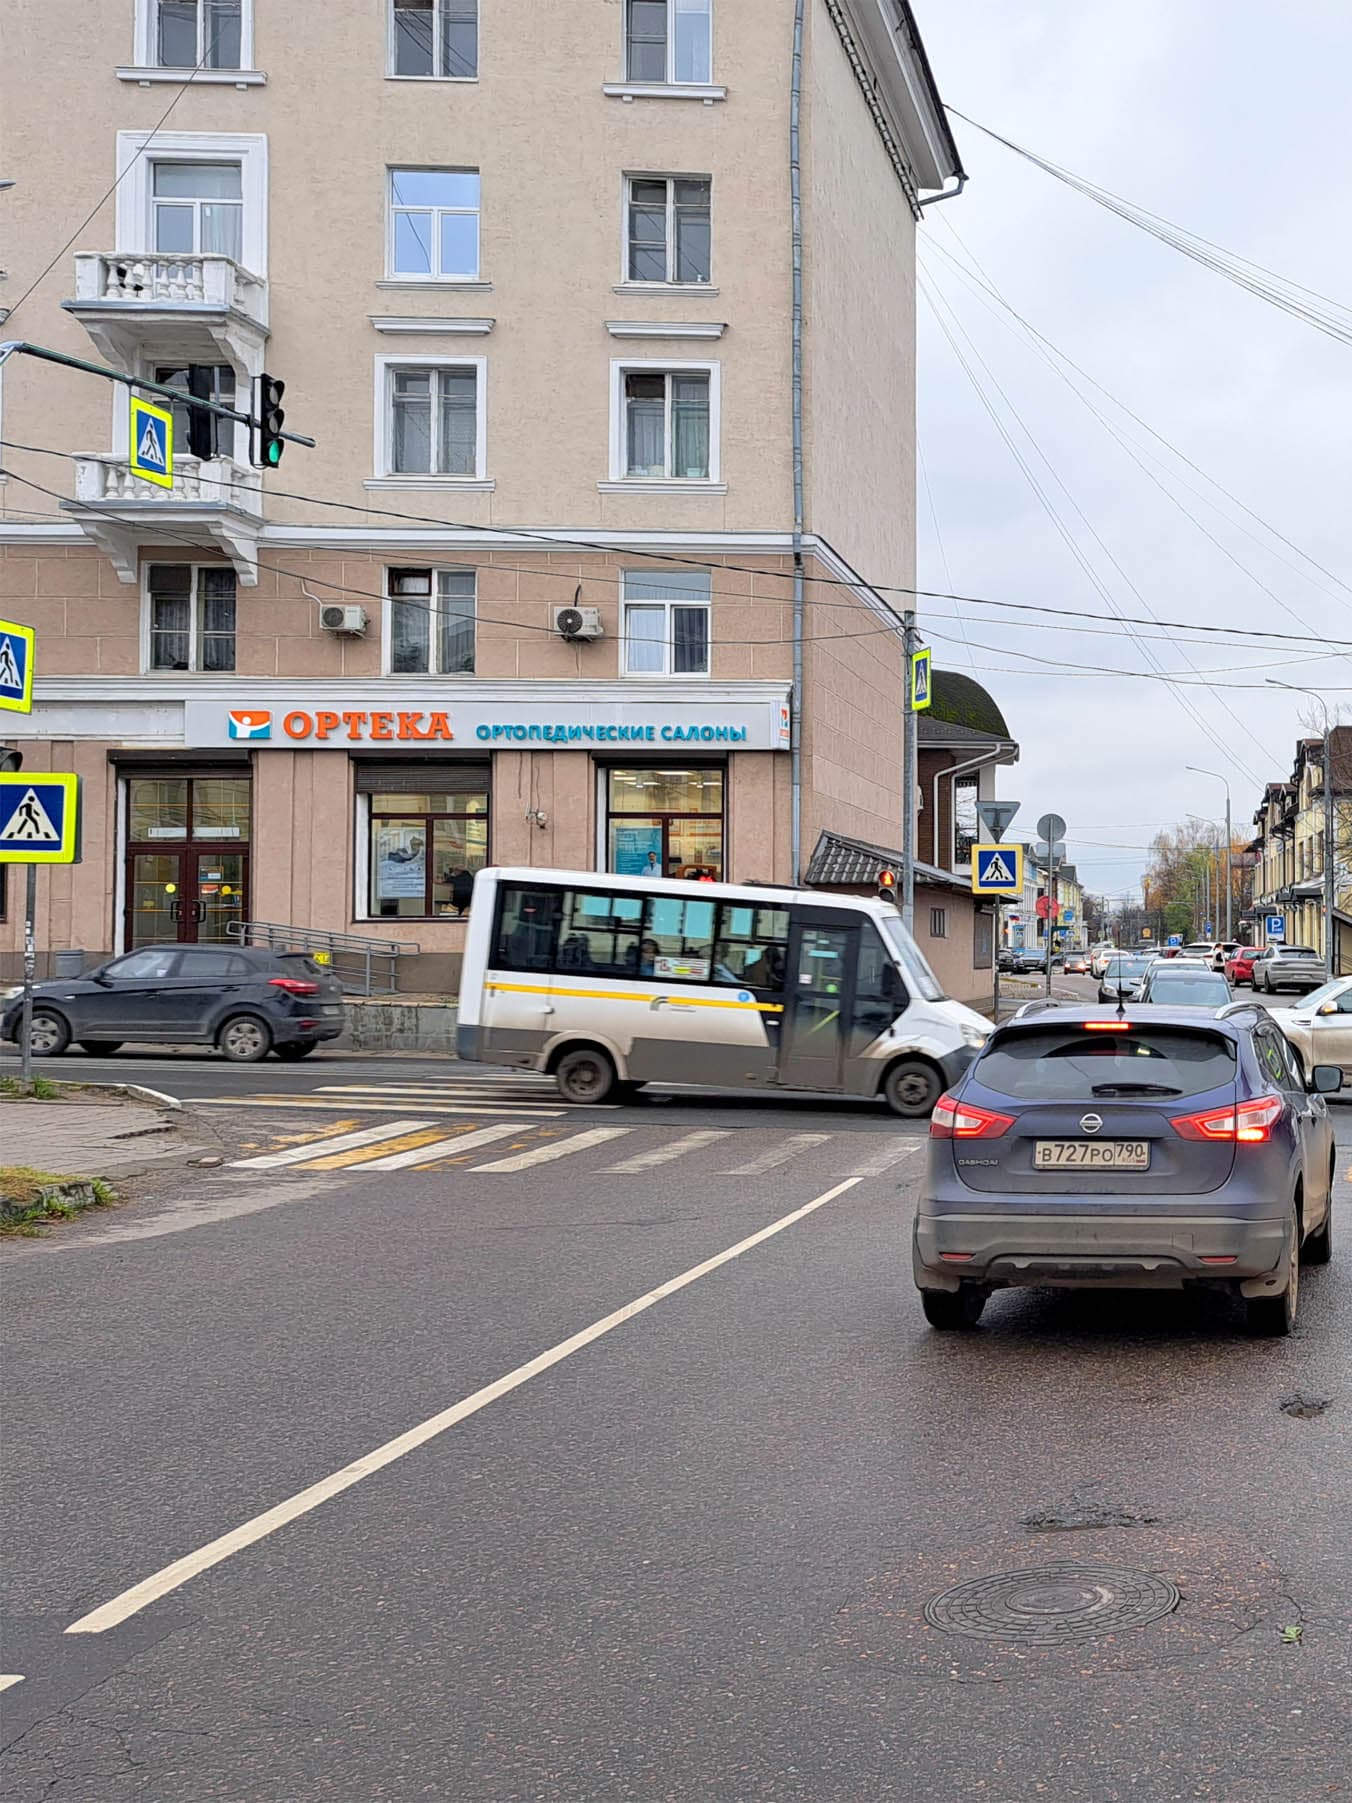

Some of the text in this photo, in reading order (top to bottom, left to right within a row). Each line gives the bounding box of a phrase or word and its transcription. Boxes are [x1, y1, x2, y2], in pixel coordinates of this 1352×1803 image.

[283, 711, 453, 740] ОРТЕКА
[476, 724, 747, 743] ОРТОПЕДИЧЕСКИЕ САЛОНЫ
